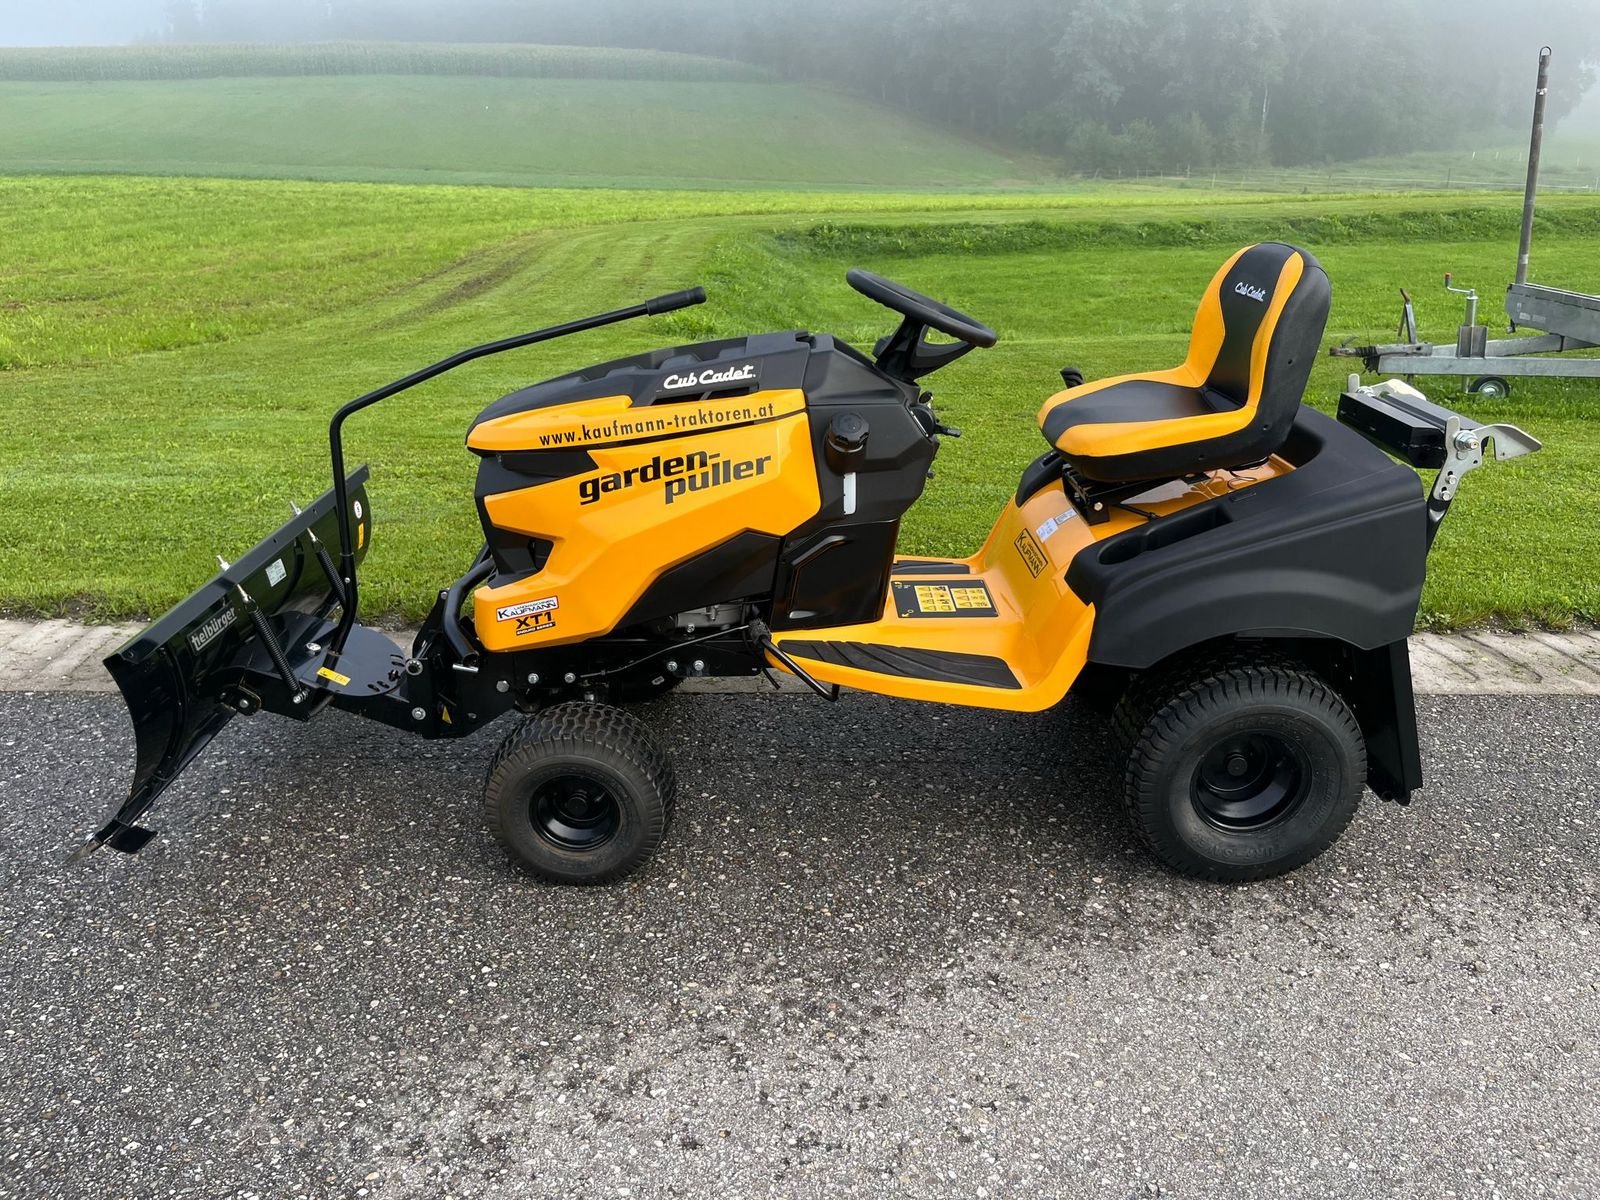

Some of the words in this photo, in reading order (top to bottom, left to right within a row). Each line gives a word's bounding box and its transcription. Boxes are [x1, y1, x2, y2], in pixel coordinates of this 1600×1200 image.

[1235, 282, 1249, 295] Cub
[663, 372, 698, 389] Cub
[539, 403, 774, 446] www.kaufmann-traktoren.at
[579, 450, 721, 506] garden-
[664, 455, 772, 505] puller
[498, 602, 556, 618] KAUFMANN
[516, 611, 552, 630] XT1
